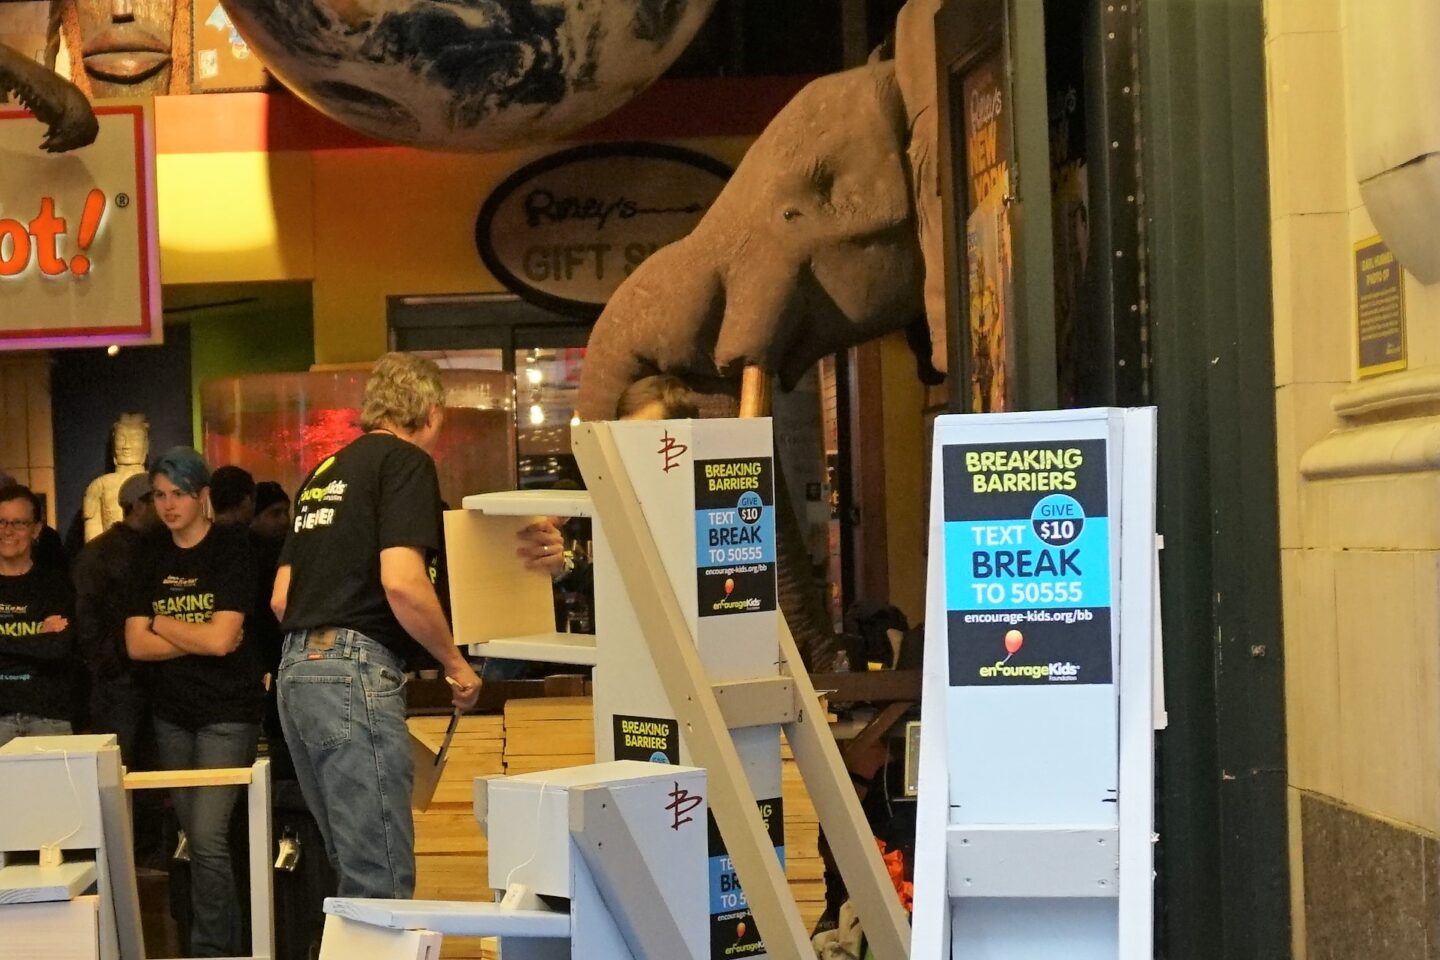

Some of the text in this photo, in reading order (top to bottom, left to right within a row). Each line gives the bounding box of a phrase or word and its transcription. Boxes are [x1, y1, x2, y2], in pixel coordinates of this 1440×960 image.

[522, 244, 611, 282] GIFT
[965, 448, 1083, 472] BREAKING
[705, 462, 762, 478] BREAKING
[708, 477, 759, 492] BARRIERS
[973, 471, 1077, 493] BARRIERS
[741, 497, 758, 506] GIVE
[708, 512, 735, 525] TEXT
[741, 508, 758, 521] $10
[1040, 504, 1074, 517] GIVE
[708, 525, 762, 547] BREAK
[971, 525, 1026, 546] TEXT
[1040, 521, 1074, 540] $10
[708, 546, 763, 563] TO 50555
[972, 548, 1082, 579] BREAK
[971, 582, 1083, 604] TO 50555
[152, 593, 214, 614] REAKING
[964, 610, 1093, 625] encourage-kids.org/bb
[621, 720, 669, 737] BREAKING
[625, 734, 667, 750] BARRIERS
[720, 858, 735, 871] TE
[720, 894, 737, 908] TO
